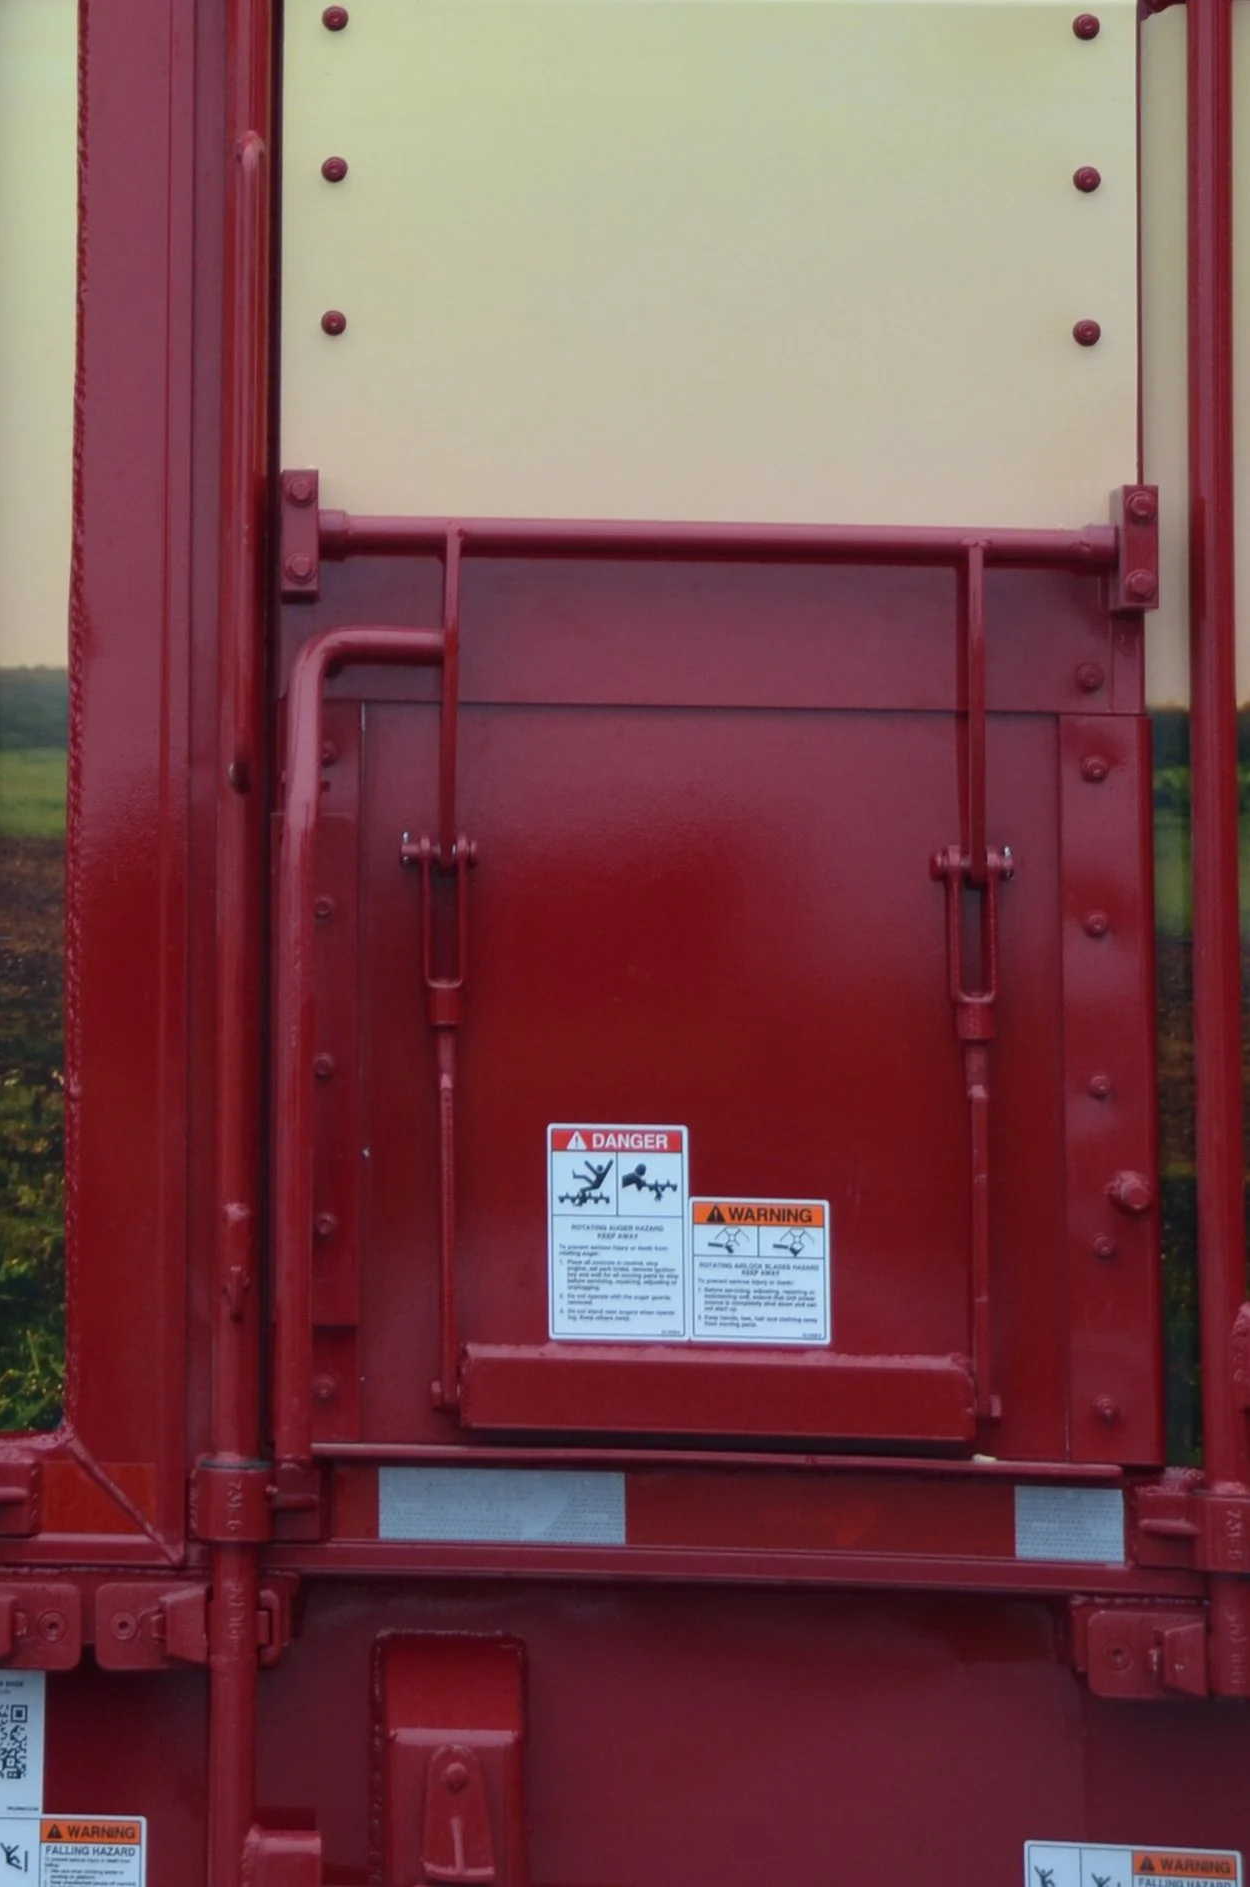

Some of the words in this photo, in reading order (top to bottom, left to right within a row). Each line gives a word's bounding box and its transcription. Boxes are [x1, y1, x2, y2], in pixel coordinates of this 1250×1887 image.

[592, 1133, 668, 1149] DANGER
[728, 1205, 813, 1223] WARNING
[67, 1825, 135, 1840] WARNING
[45, 1845, 90, 1856] FALLING
[92, 1847, 136, 1857] HAZARD
[1160, 1858, 1231, 1874] WARNING
